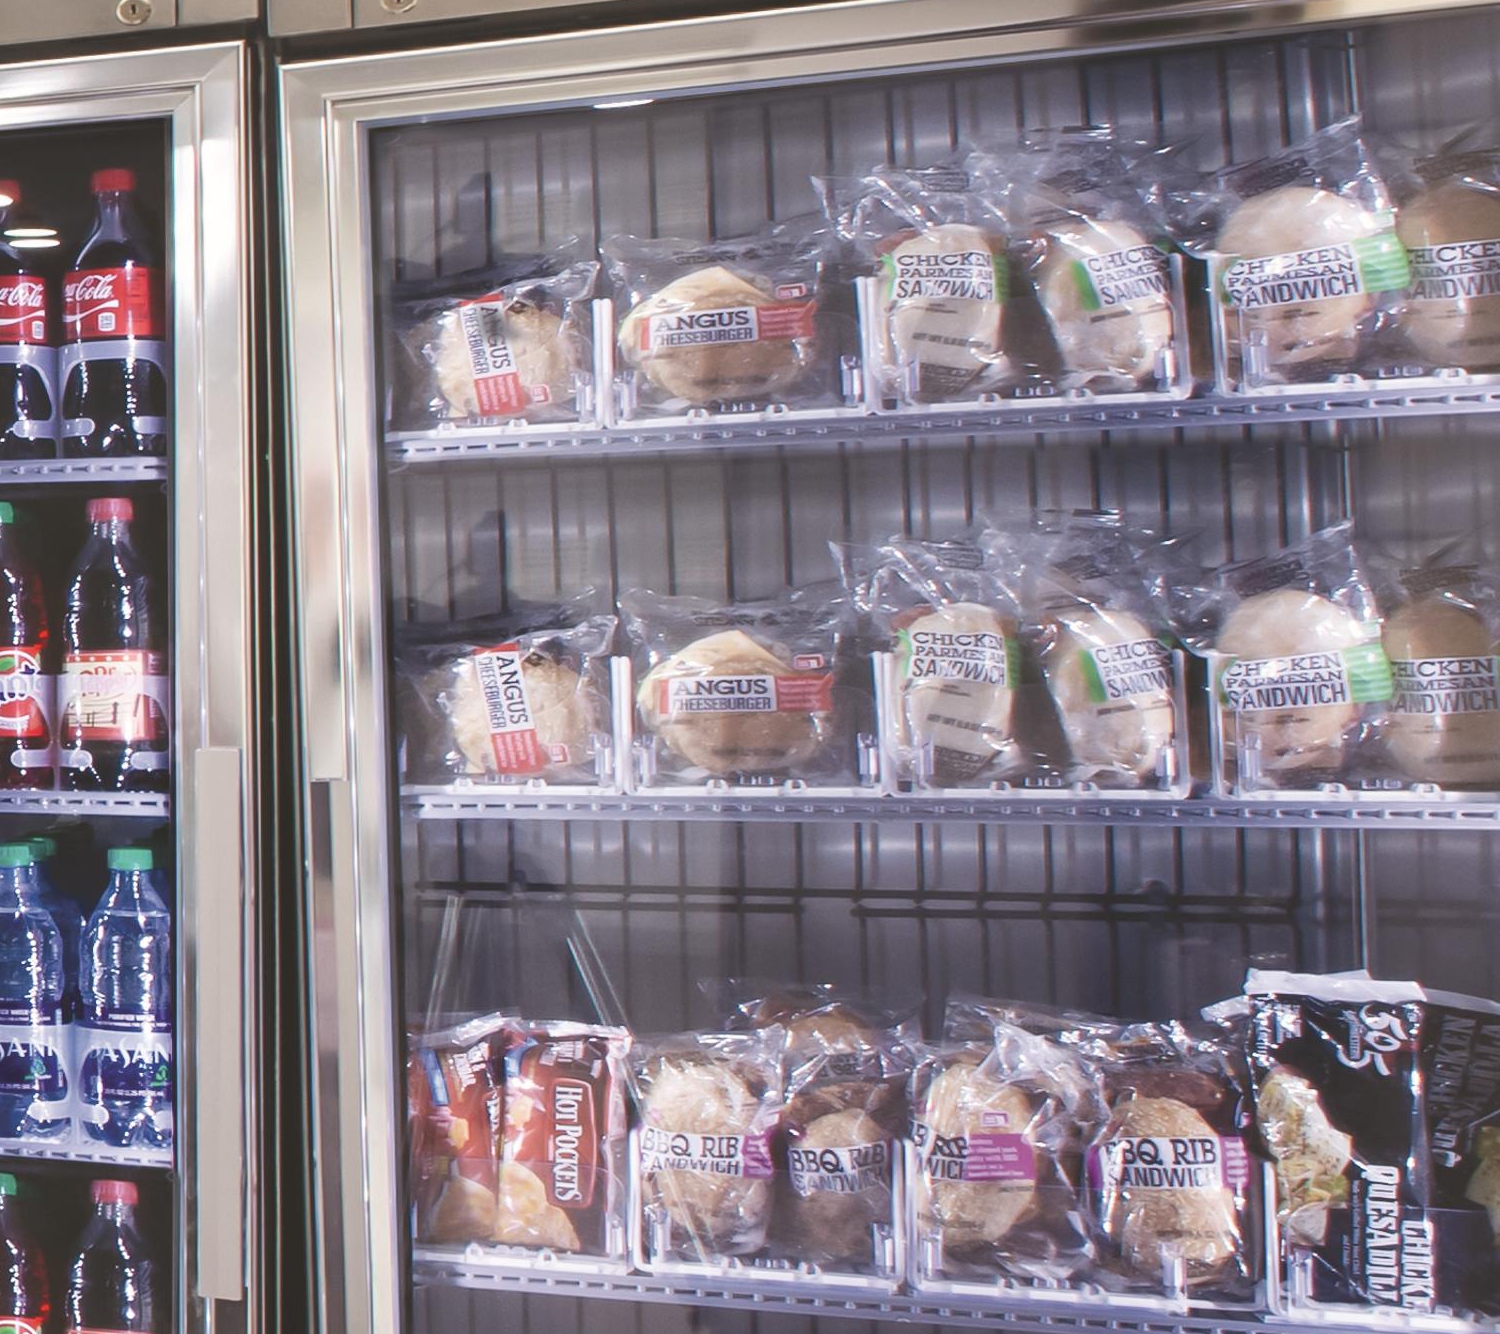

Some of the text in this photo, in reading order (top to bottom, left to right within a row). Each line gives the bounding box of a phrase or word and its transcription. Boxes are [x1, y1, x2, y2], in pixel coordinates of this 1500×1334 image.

[897, 252, 992, 268] CHICKEN
[1225, 244, 1353, 279] CHCKEN
[896, 279, 995, 303] SANDWICH
[1228, 273, 1360, 309] SANDWICH
[653, 310, 751, 330] ANGUS
[911, 630, 1004, 649] CHICKEN
[911, 658, 1007, 687] SANDWICH
[1224, 649, 1343, 679] CHCKEN
[495, 655, 529, 726] ANGUS
[673, 677, 769, 697] ANGUS
[1227, 681, 1347, 712] SANDWICH
[553, 1085, 583, 1202] HOT POCKETS
[641, 1130, 741, 1159] BBQ RIB
[1170, 1136, 1217, 1165] RIB
[789, 1147, 844, 1174] BBQ
